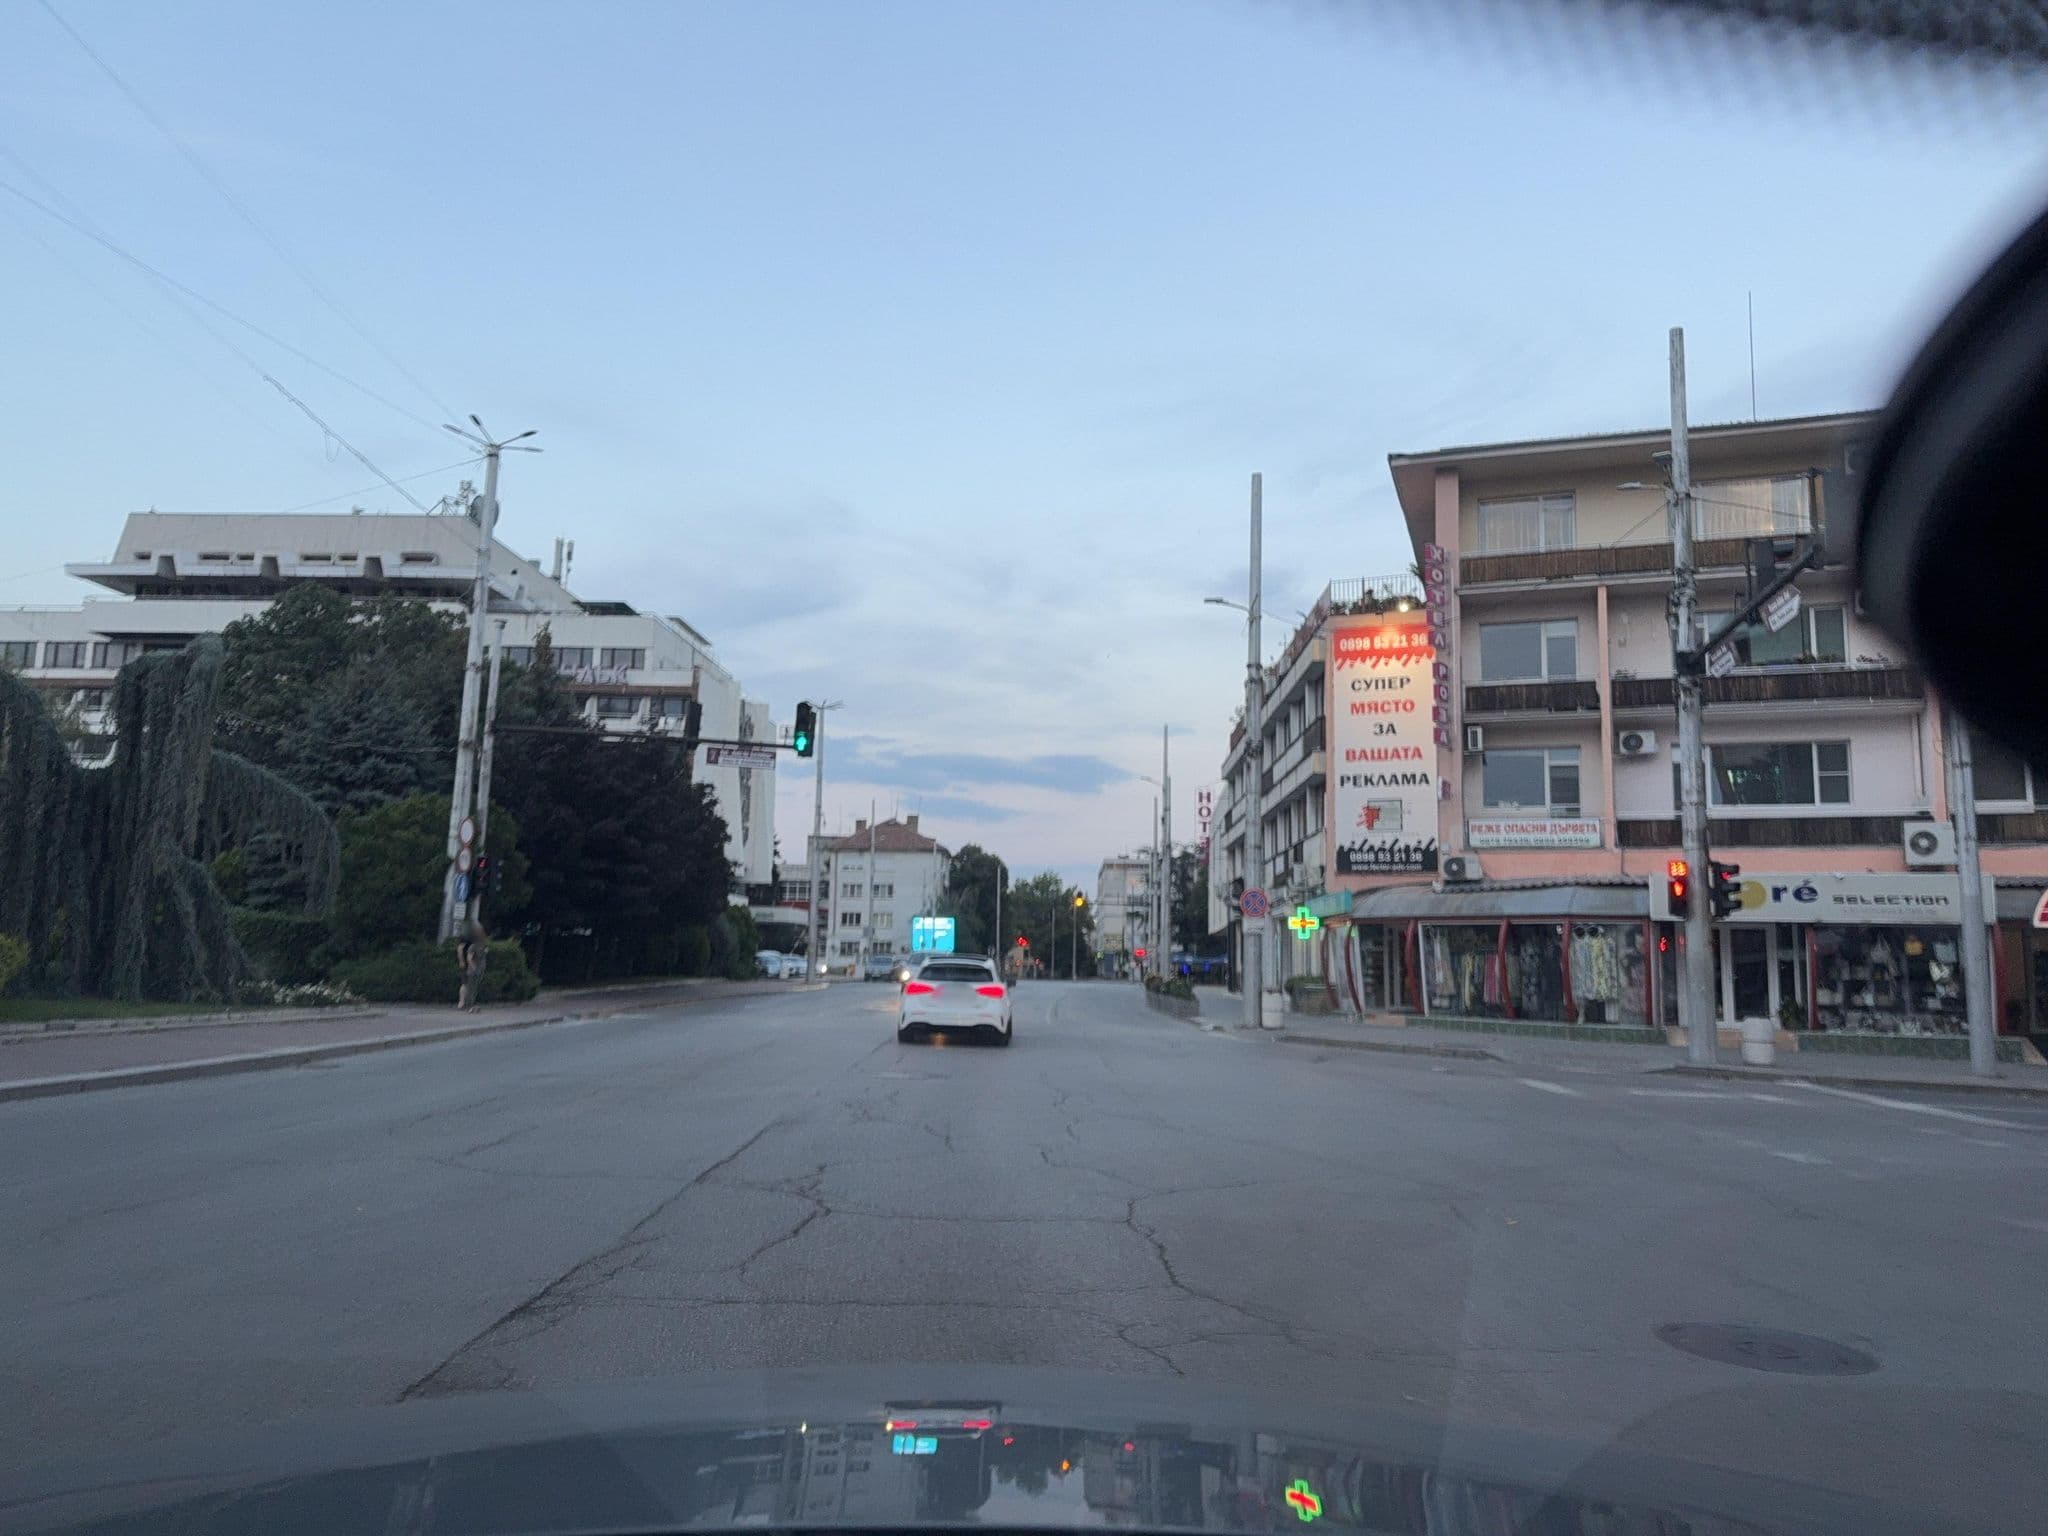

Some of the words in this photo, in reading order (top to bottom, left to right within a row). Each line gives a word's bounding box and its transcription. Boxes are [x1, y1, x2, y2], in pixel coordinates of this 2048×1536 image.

[1351, 676, 1411, 691] СУПЕР
[1350, 700, 1415, 715] МЯСТО
[1373, 722, 1397, 736] ЗА
[1345, 747, 1423, 762] ВАШАТА
[1340, 773, 1430, 788] РЕКЛАМА
[1832, 895, 1949, 905] SELECTION
